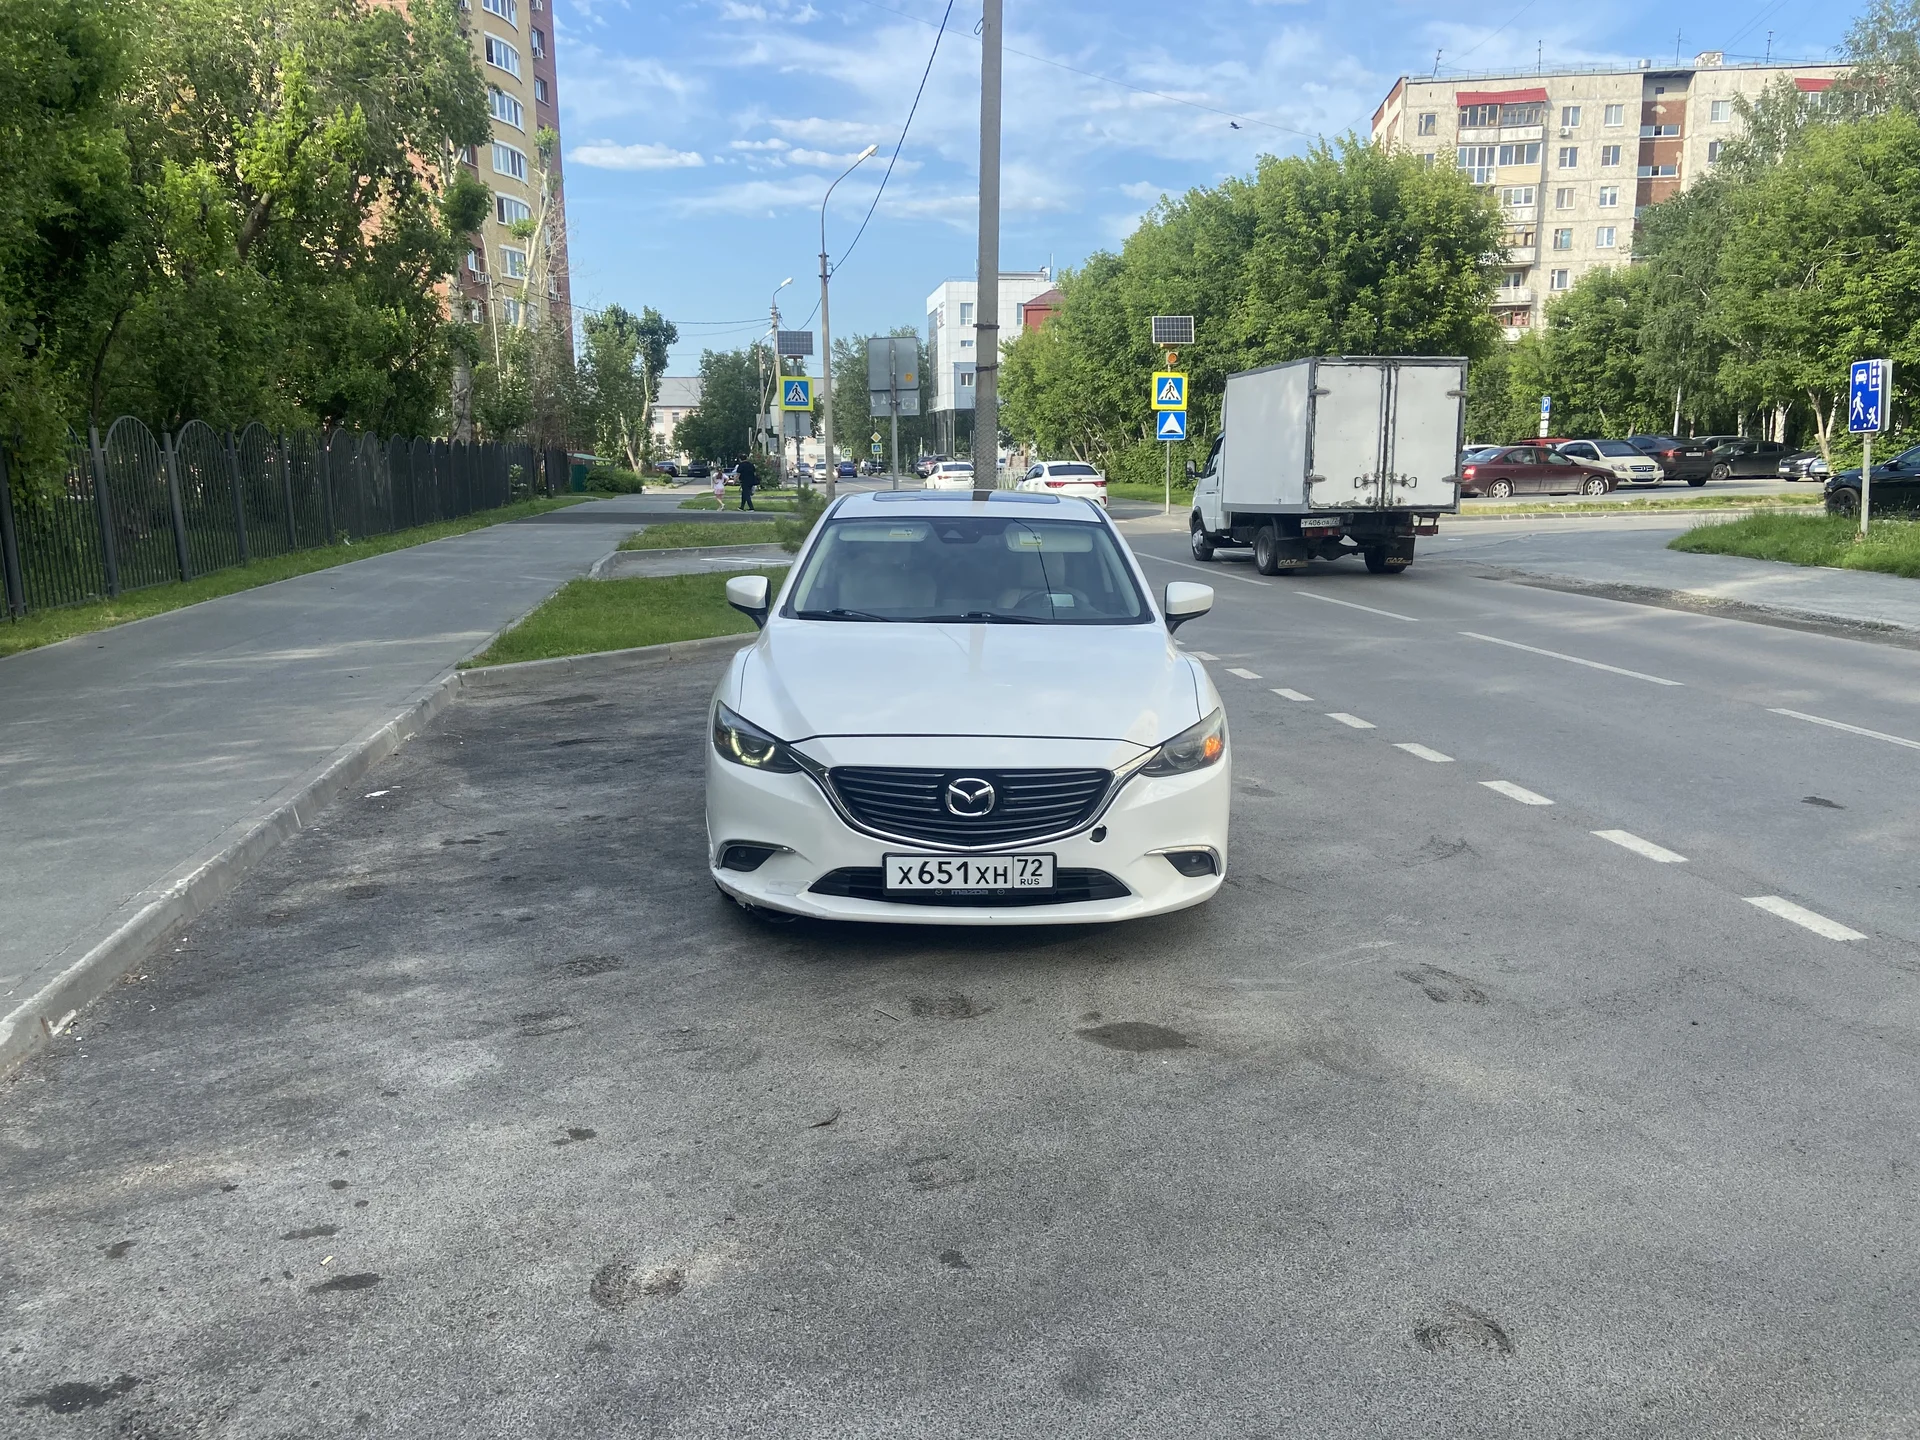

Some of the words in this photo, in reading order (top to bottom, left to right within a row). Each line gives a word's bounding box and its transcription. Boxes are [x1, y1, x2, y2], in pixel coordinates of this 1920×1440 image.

[1544, 399, 1549, 411] P
[898, 861, 1008, 884] Х651ХН
[1016, 859, 1043, 877] 72
[1020, 878, 1040, 886] RUS
